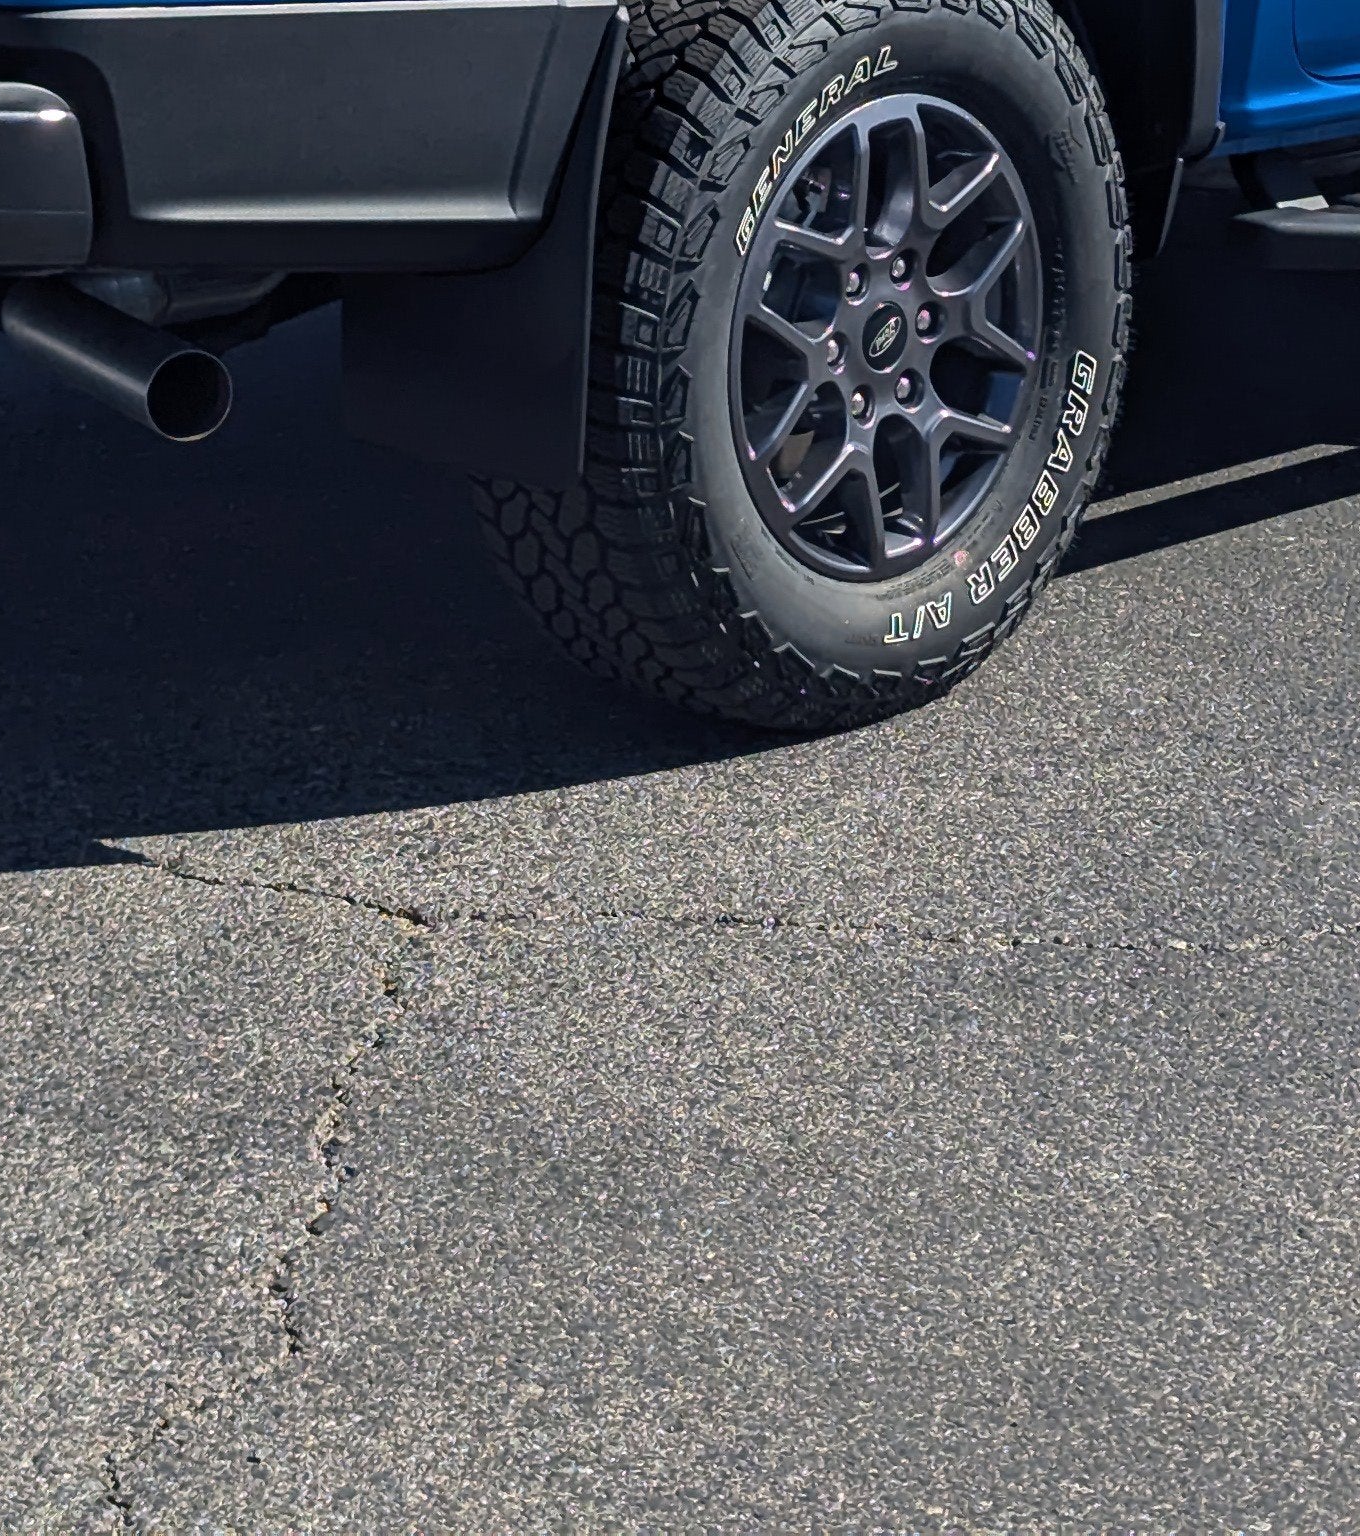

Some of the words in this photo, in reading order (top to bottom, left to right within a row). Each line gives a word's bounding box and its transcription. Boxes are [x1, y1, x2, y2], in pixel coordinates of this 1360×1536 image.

[735, 45, 899, 256] GENERAL
[967, 350, 1097, 604] GRABBER
[883, 591, 953, 644] A/T
